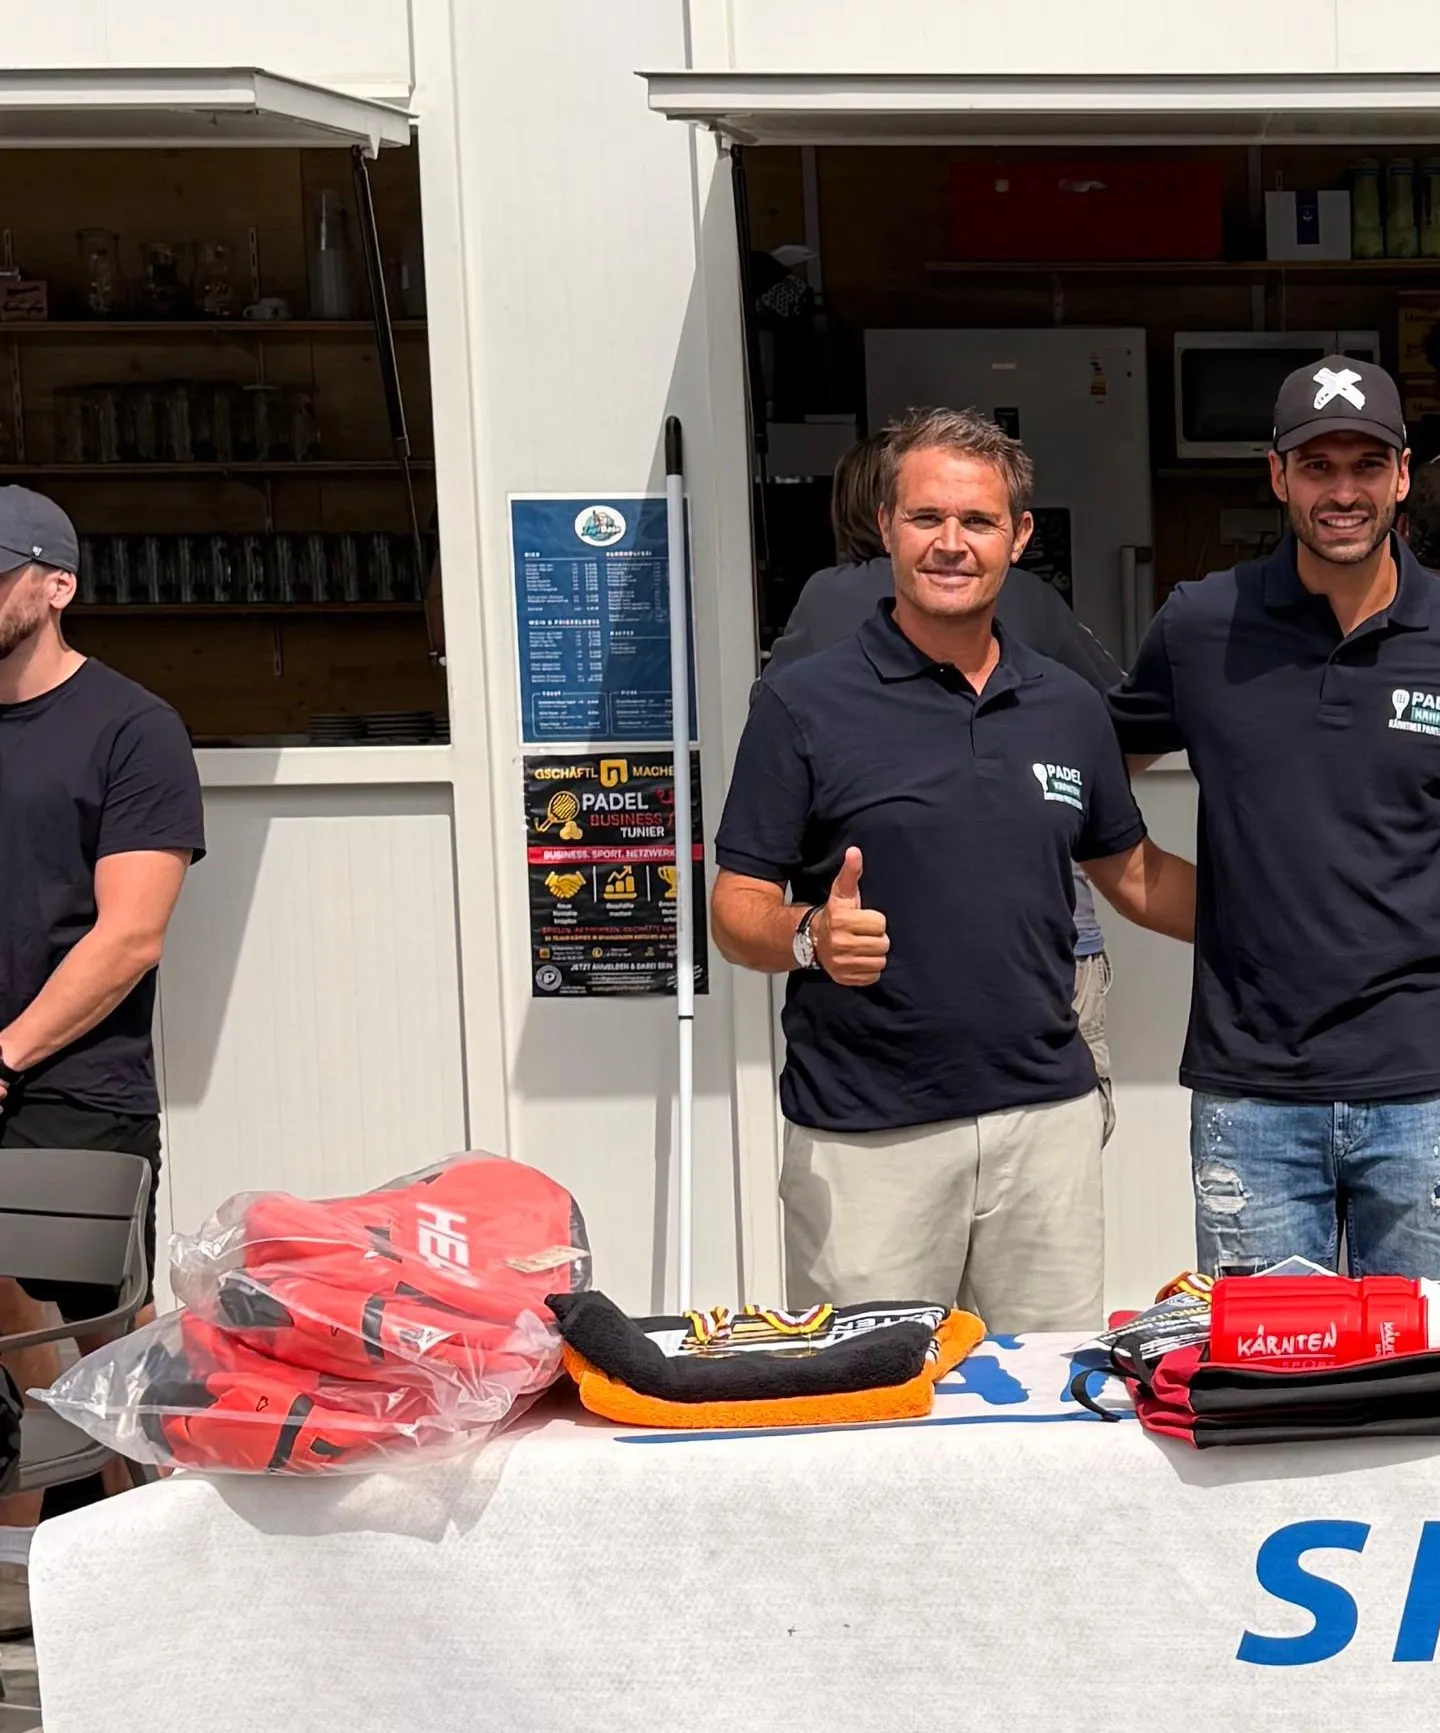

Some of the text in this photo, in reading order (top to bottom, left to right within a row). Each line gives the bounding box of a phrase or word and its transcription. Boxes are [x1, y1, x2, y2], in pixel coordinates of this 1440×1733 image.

[534, 765, 675, 780] GSCHÄFTL MACHE
[1046, 763, 1082, 786] PADEL
[582, 792, 649, 812] PADEL
[590, 812, 662, 826] BUSINESS
[620, 826, 665, 838] TUNIER
[416, 1203, 480, 1288] HEA
[1237, 1321, 1338, 1357] KÄRNTEN
